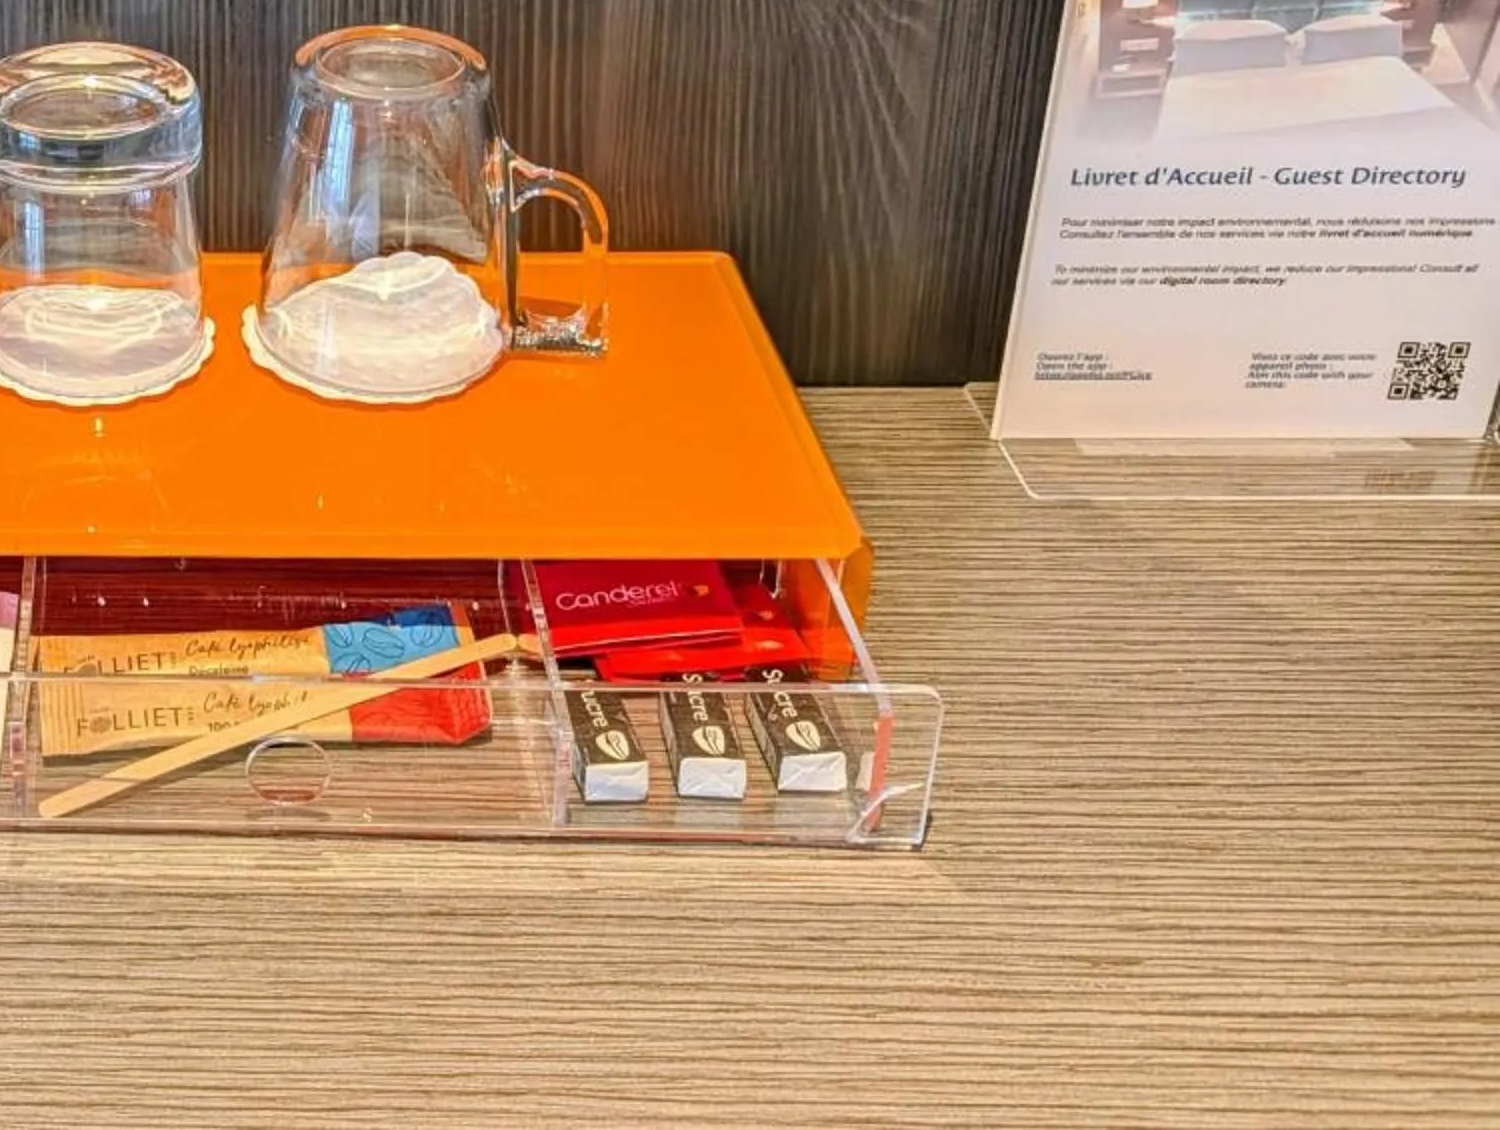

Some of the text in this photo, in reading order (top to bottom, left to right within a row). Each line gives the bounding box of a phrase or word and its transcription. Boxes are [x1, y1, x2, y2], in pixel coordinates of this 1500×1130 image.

[1070, 167, 1138, 186] Livret
[1144, 166, 1253, 185] d'Accueil
[1274, 166, 1343, 185] Guest
[1350, 165, 1467, 188] Directory
[1061, 217, 1088, 227] Pour
[1090, 217, 1144, 227] minimiser
[1146, 217, 1175, 227] notre
[1177, 217, 1216, 229] impact
[1315, 217, 1344, 226] nous
[1059, 229, 1116, 240] Consultez
[1179, 229, 1194, 239] de
[1219, 229, 1265, 239] services
[1287, 229, 1317, 239] notre
[1318, 228, 1350, 239] livret
[1159, 275, 1197, 288] digital
[1198, 276, 1230, 286] room
[555, 579, 679, 611] Canderel
[185, 639, 221, 658] Café
[203, 691, 241, 713] Café
